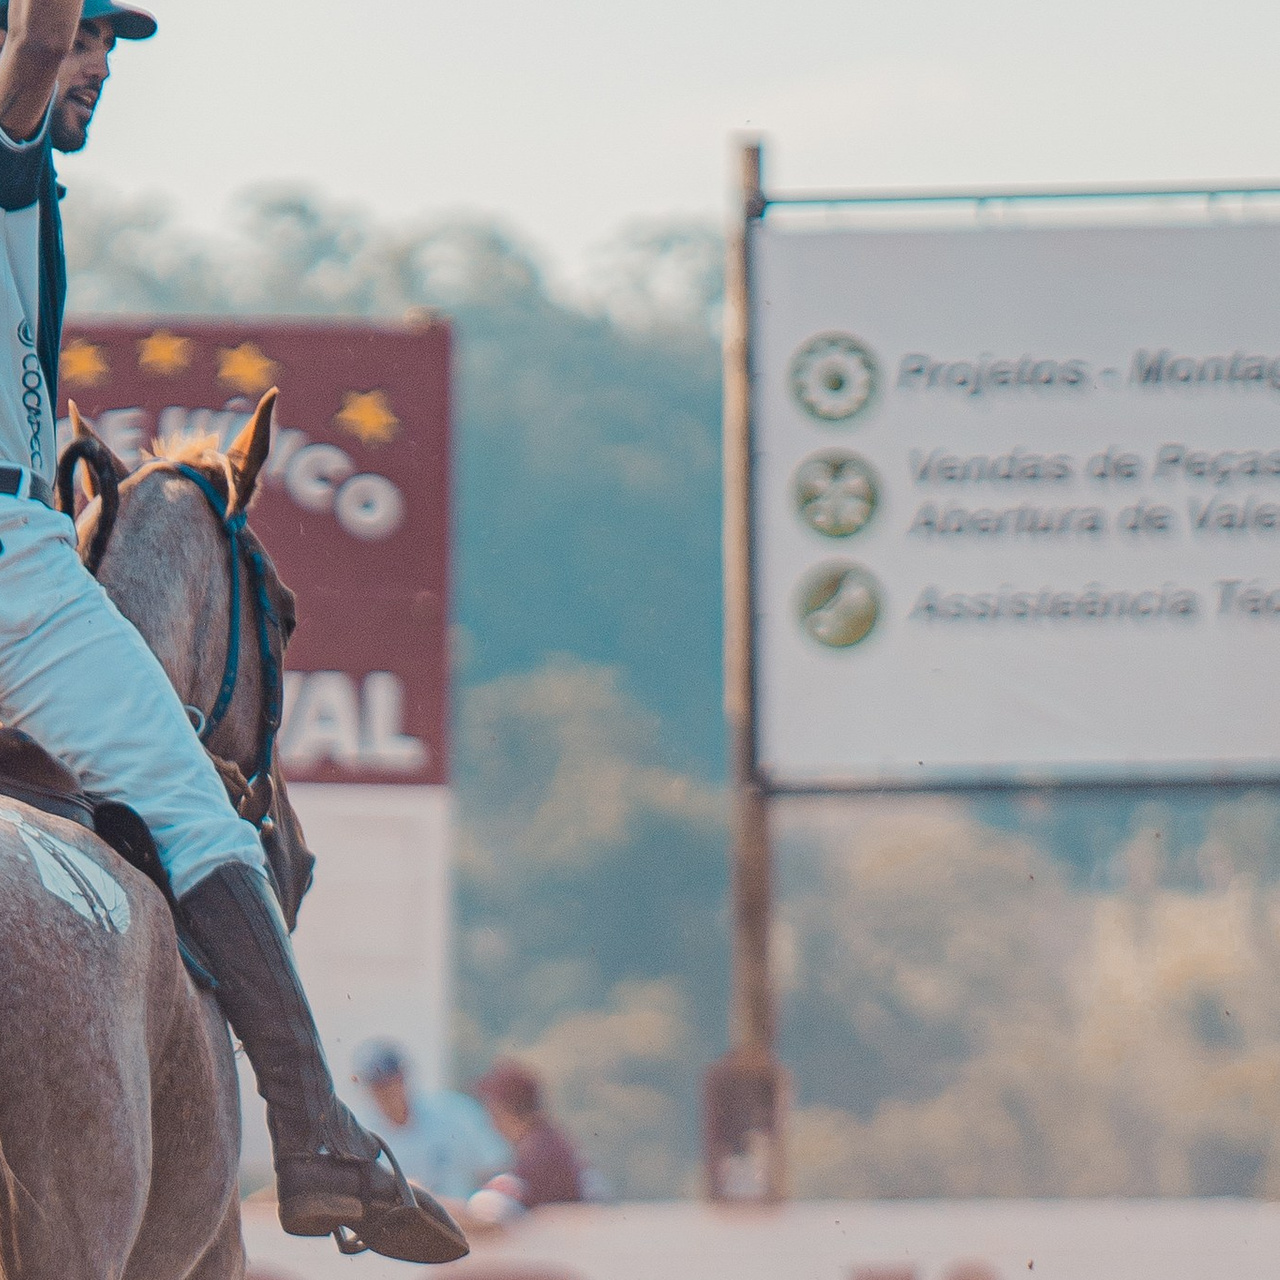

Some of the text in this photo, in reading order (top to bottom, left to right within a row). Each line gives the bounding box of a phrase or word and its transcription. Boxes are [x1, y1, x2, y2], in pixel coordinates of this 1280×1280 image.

[898, 351, 1087, 397] Projetos
[907, 446, 1071, 482] Vendas
[1087, 444, 1142, 482] de
[1122, 498, 1177, 533] de
